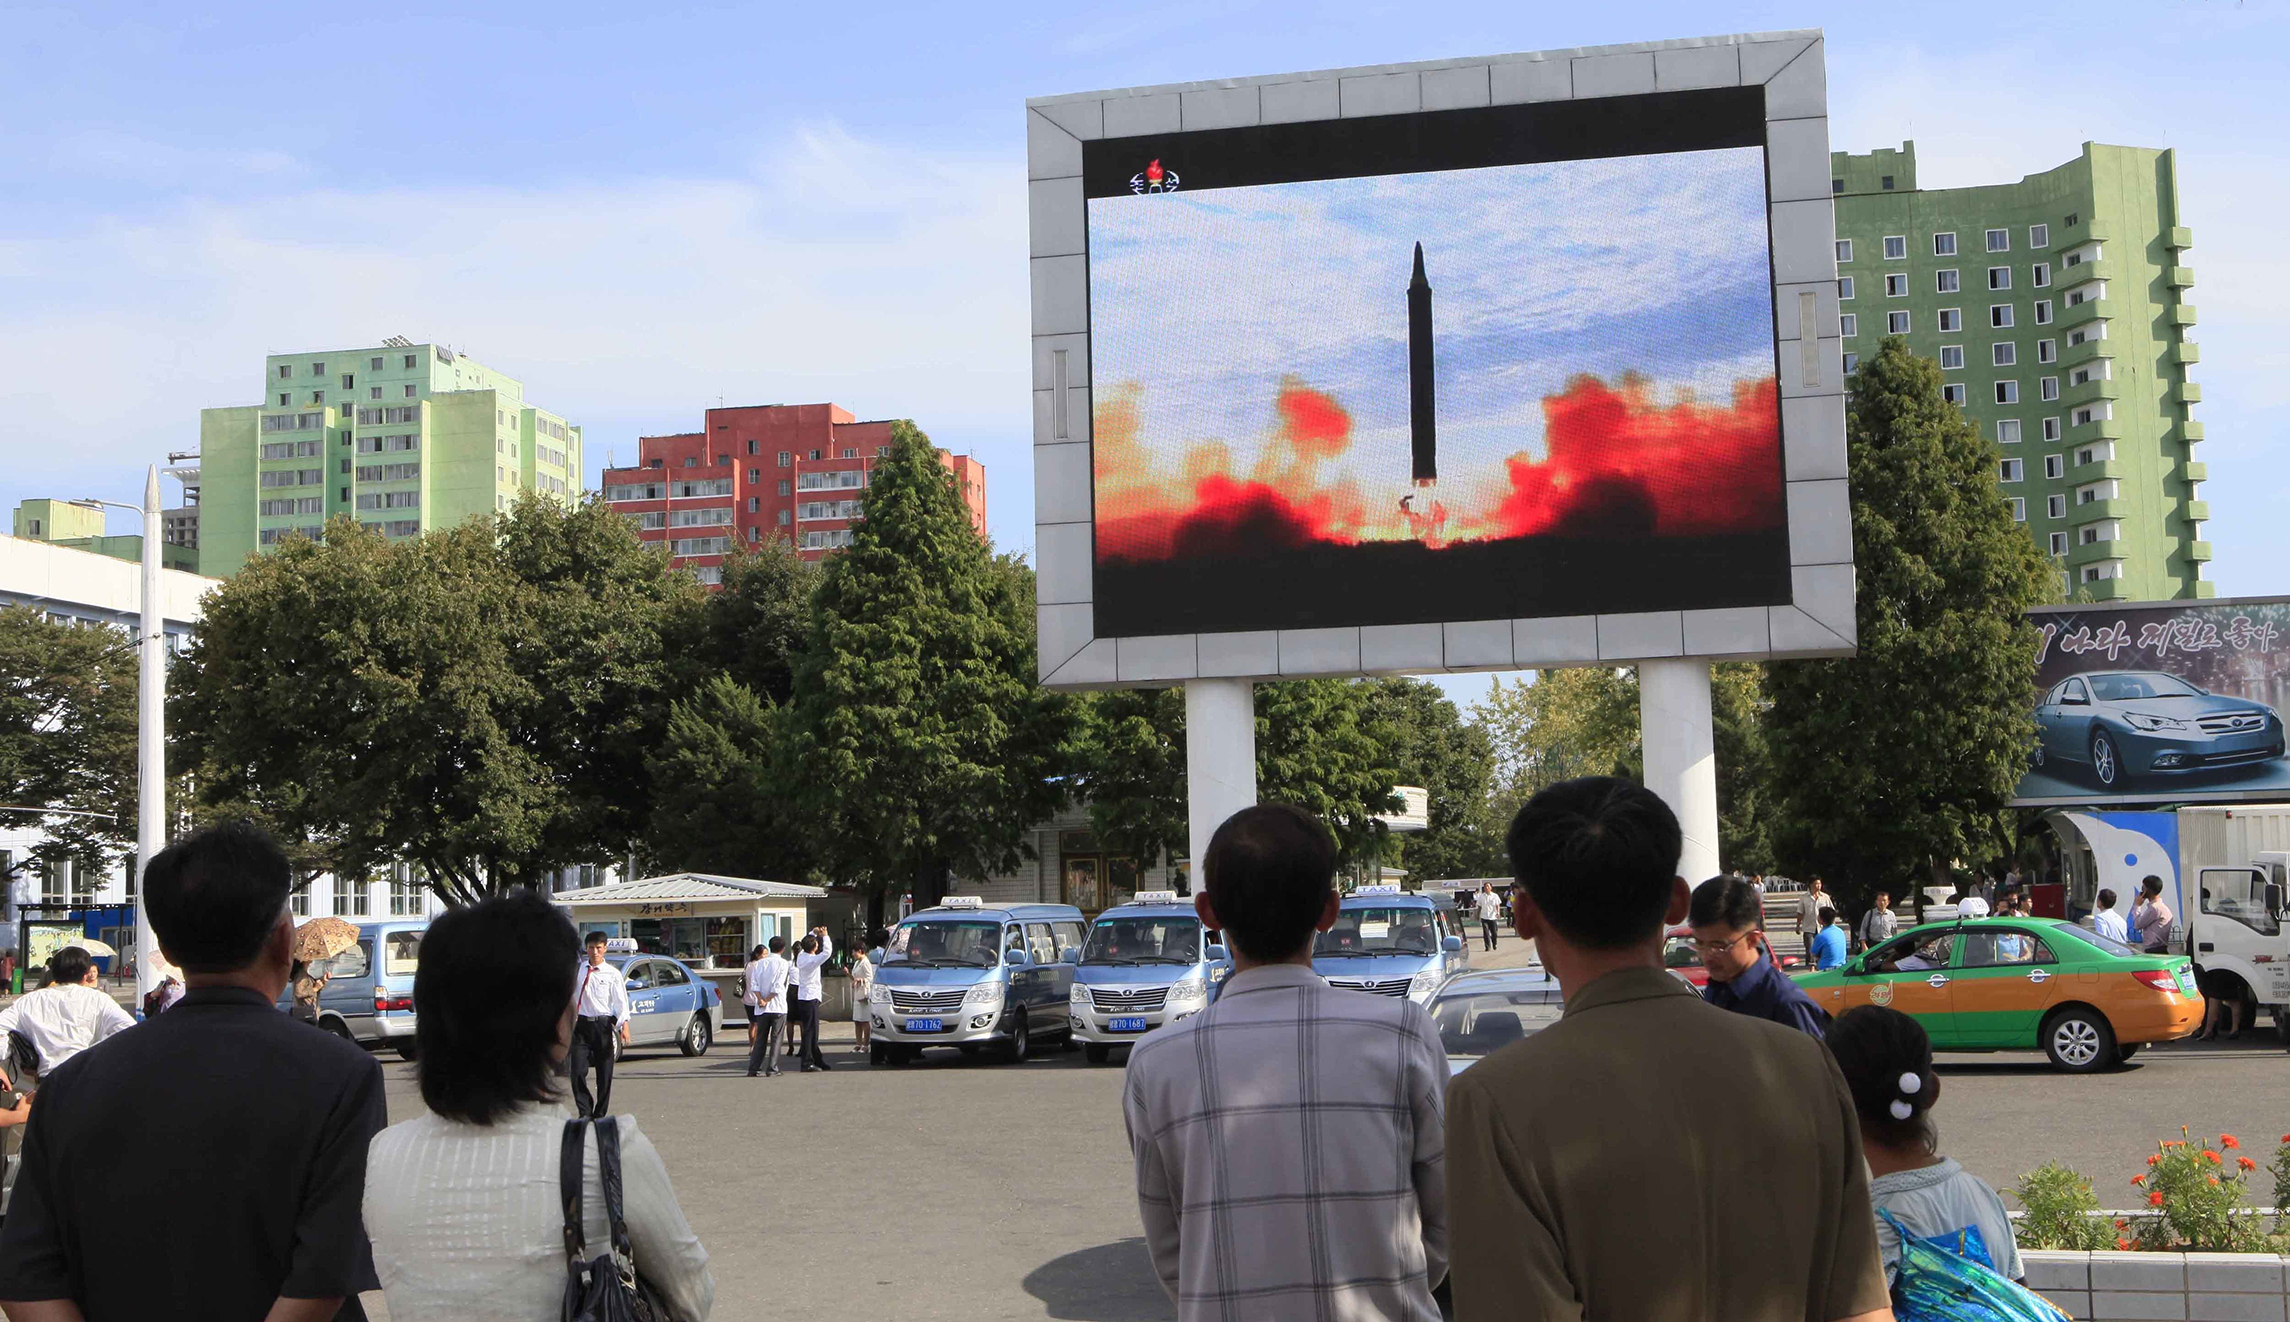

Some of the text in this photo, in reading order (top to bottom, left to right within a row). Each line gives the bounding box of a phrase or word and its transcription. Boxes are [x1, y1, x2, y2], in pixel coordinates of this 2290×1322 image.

[2060, 620, 2132, 661] 나라
[2137, 618, 2222, 657] 제일로
[2223, 616, 2279, 652] 좋아
[1361, 885, 1394, 893] TAXI
